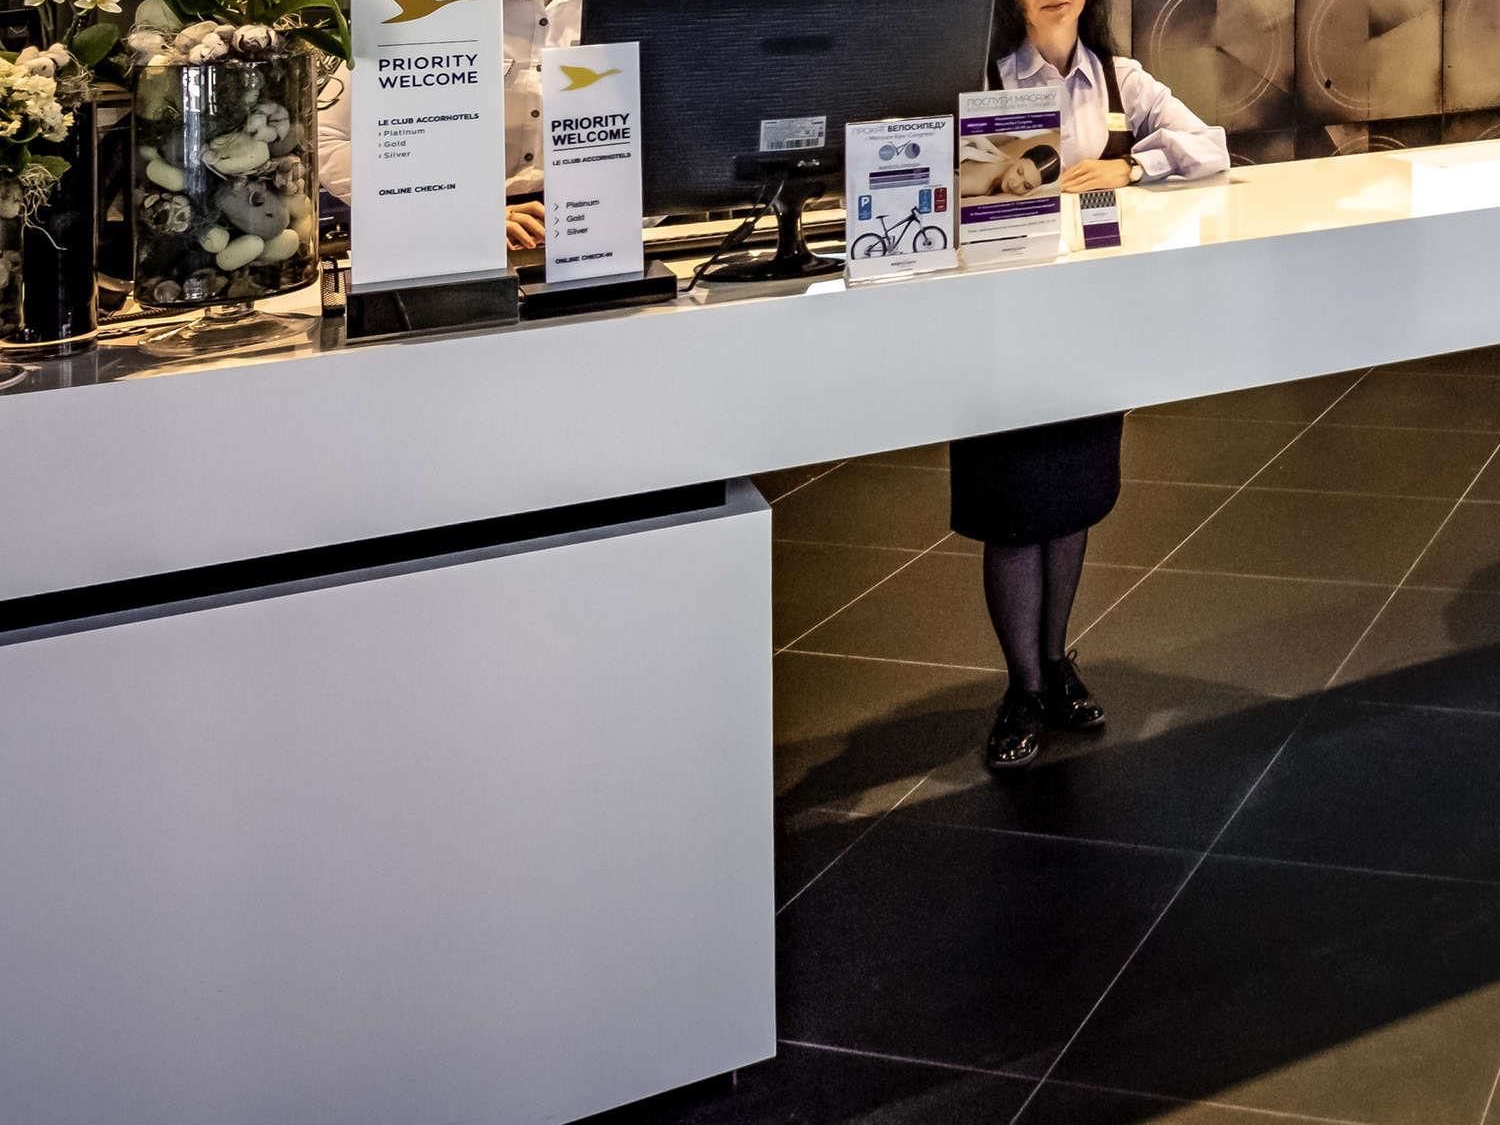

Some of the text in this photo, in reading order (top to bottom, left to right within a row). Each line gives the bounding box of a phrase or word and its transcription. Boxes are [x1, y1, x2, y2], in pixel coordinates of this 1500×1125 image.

[378, 54, 479, 72] PRIORITY
[378, 70, 479, 89] WELCOME
[378, 112, 480, 126] LE CLUB ACCORHOTELS
[551, 113, 630, 132] PRIORITY
[384, 127, 426, 137] Platinum
[887, 121, 947, 133] ВЕЛОСИПЕДУ
[384, 139, 407, 148] Gold
[552, 128, 631, 147] WELCOME
[384, 151, 411, 159] Silver
[552, 152, 632, 166] LE CLUB ACCORHOTELS
[378, 183, 457, 196] ONLINE CHECK-IN
[566, 199, 600, 209] Platinum
[566, 214, 586, 223] Gold
[567, 227, 588, 236] Silver
[555, 251, 613, 265] ONLINE CHECK-IN
